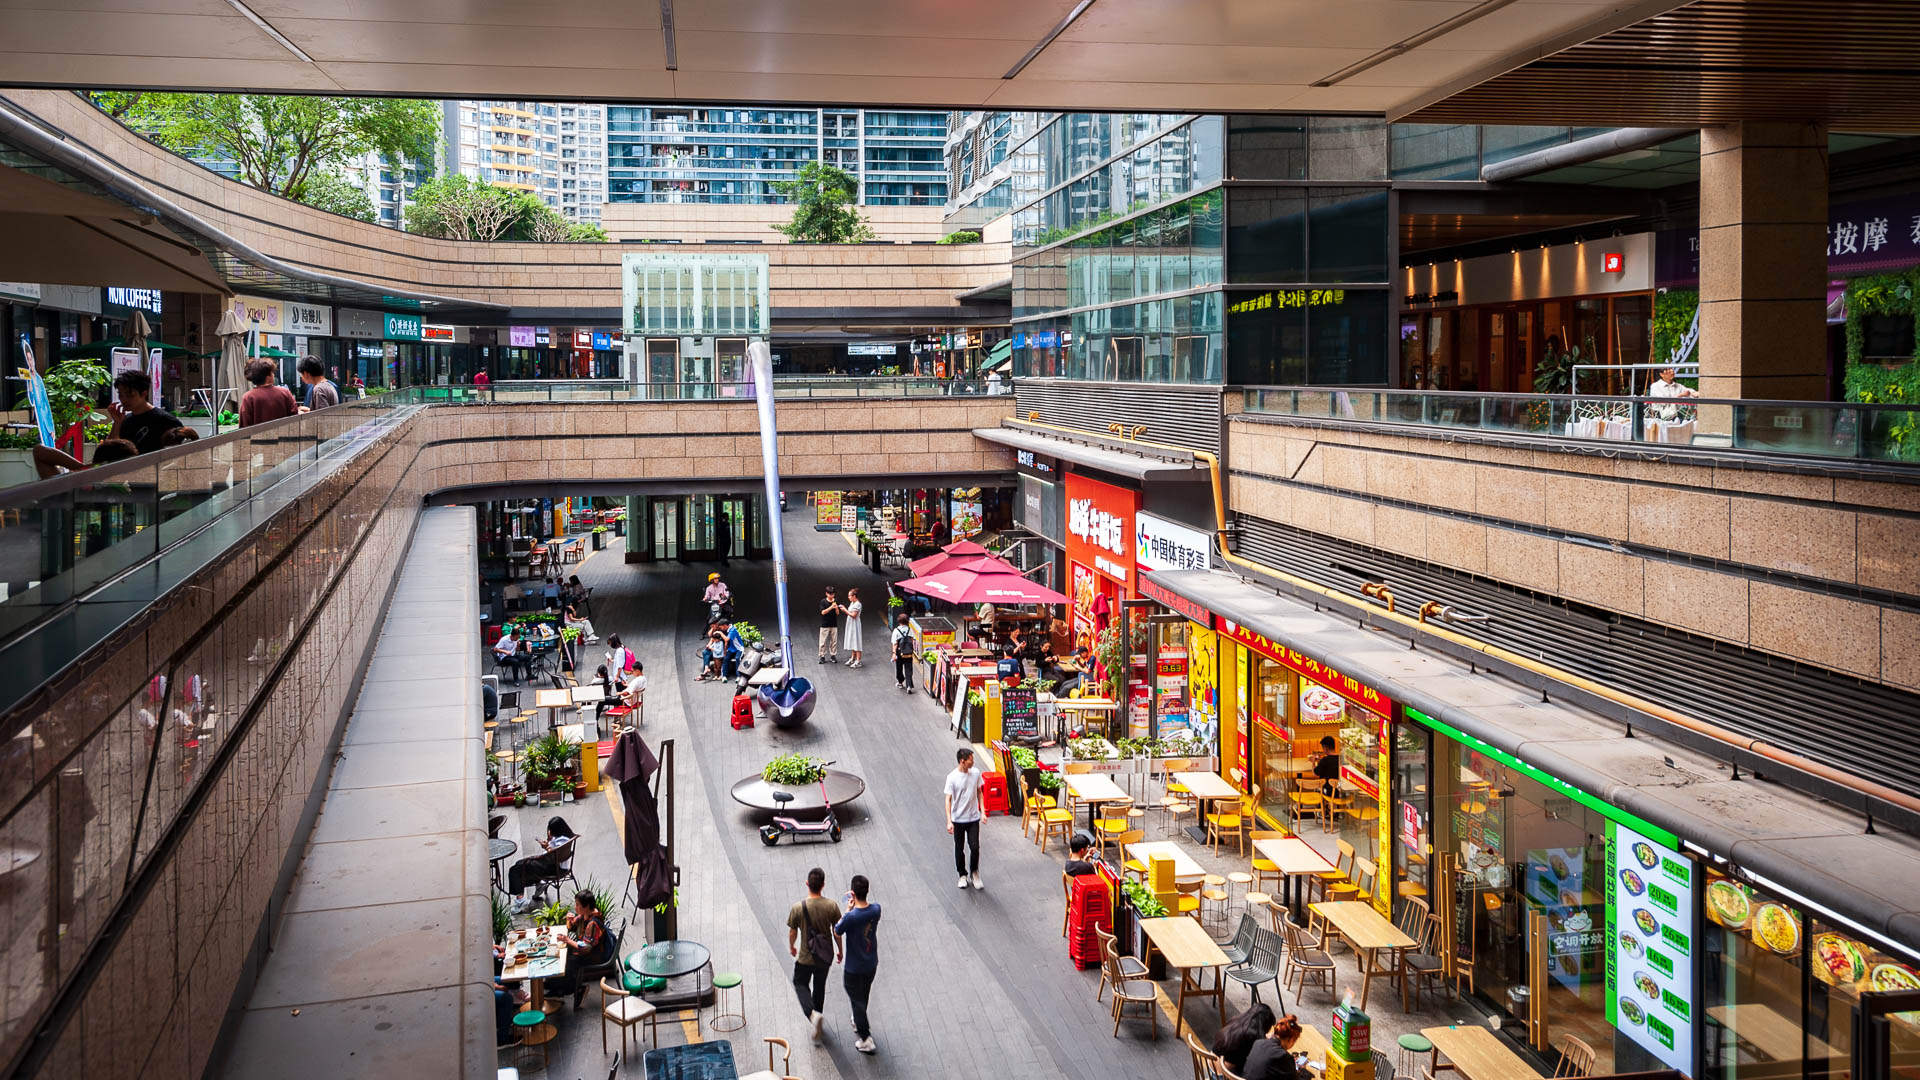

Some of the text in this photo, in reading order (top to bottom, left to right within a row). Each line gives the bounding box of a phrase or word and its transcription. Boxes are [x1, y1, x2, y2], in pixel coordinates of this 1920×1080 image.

[1827, 218, 1888, 256] 按摩
[126, 288, 152, 310] COFFEE
[1151, 534, 1205, 570] 中国体育彩票
[1553, 933, 1604, 949] 空调开放
